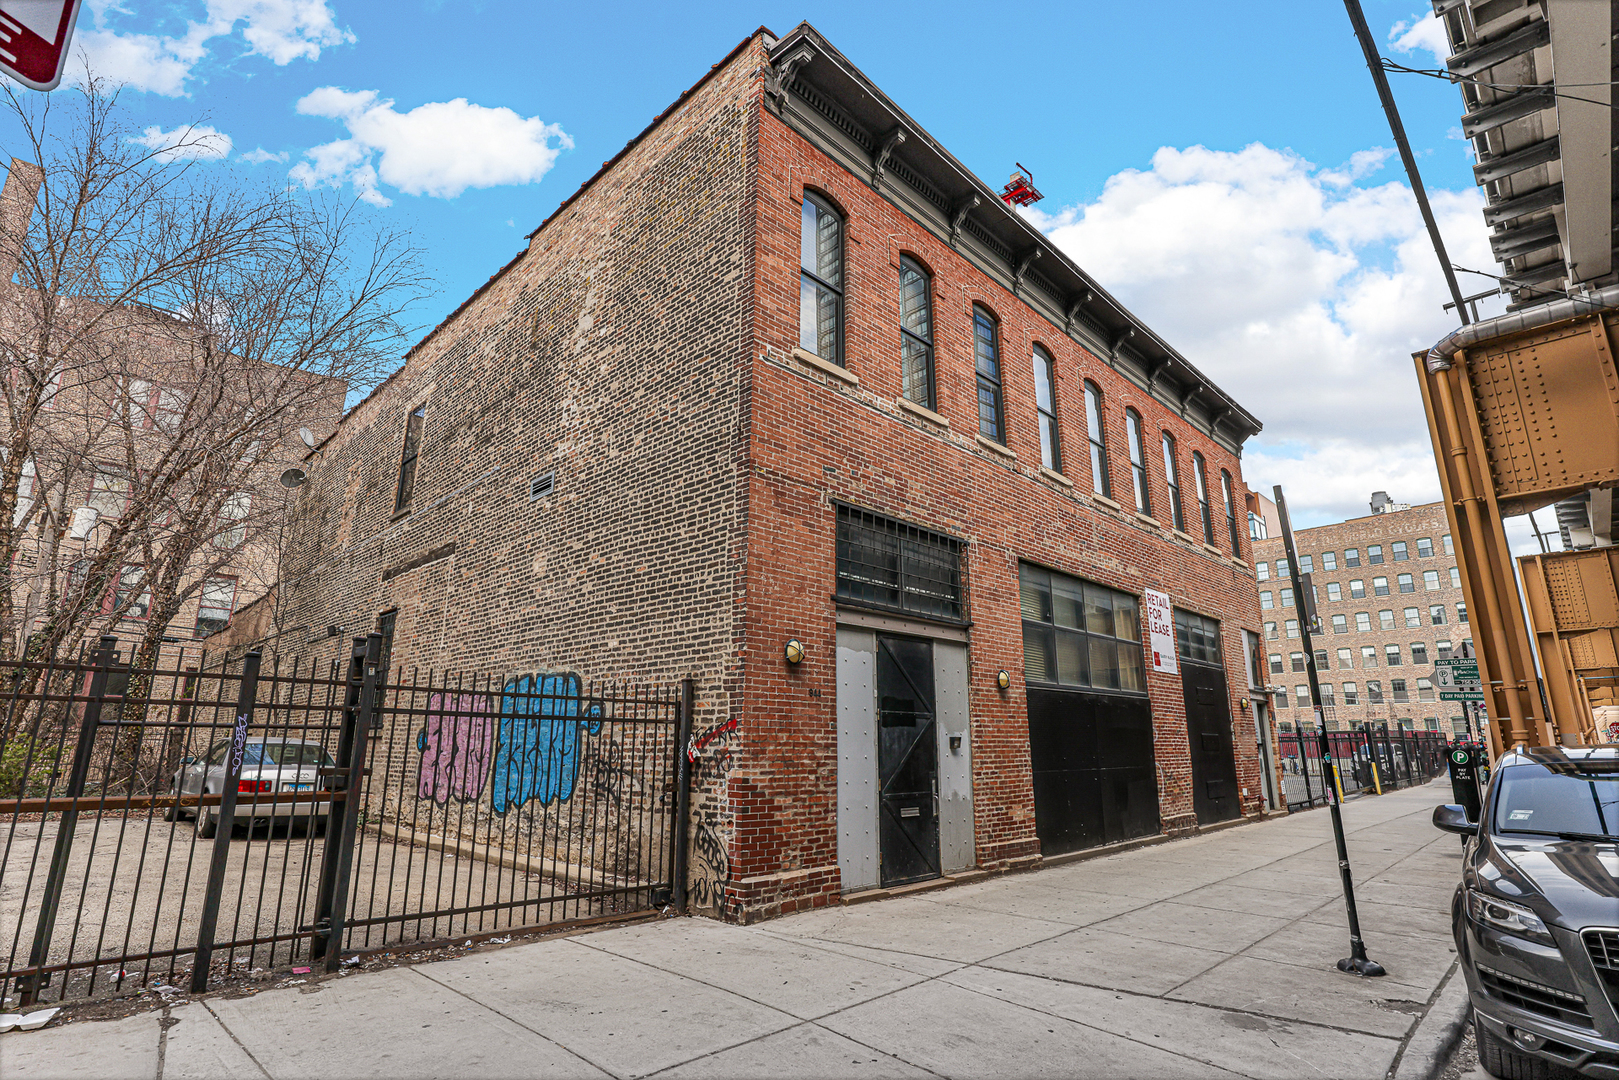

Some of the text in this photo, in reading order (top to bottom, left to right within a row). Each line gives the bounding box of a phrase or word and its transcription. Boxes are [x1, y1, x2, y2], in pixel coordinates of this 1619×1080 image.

[1147, 593, 1169, 609] RETAIL
[1149, 607, 1162, 621] FOR
[1150, 622, 1170, 636] LEASE
[809, 688, 821, 698] 944
